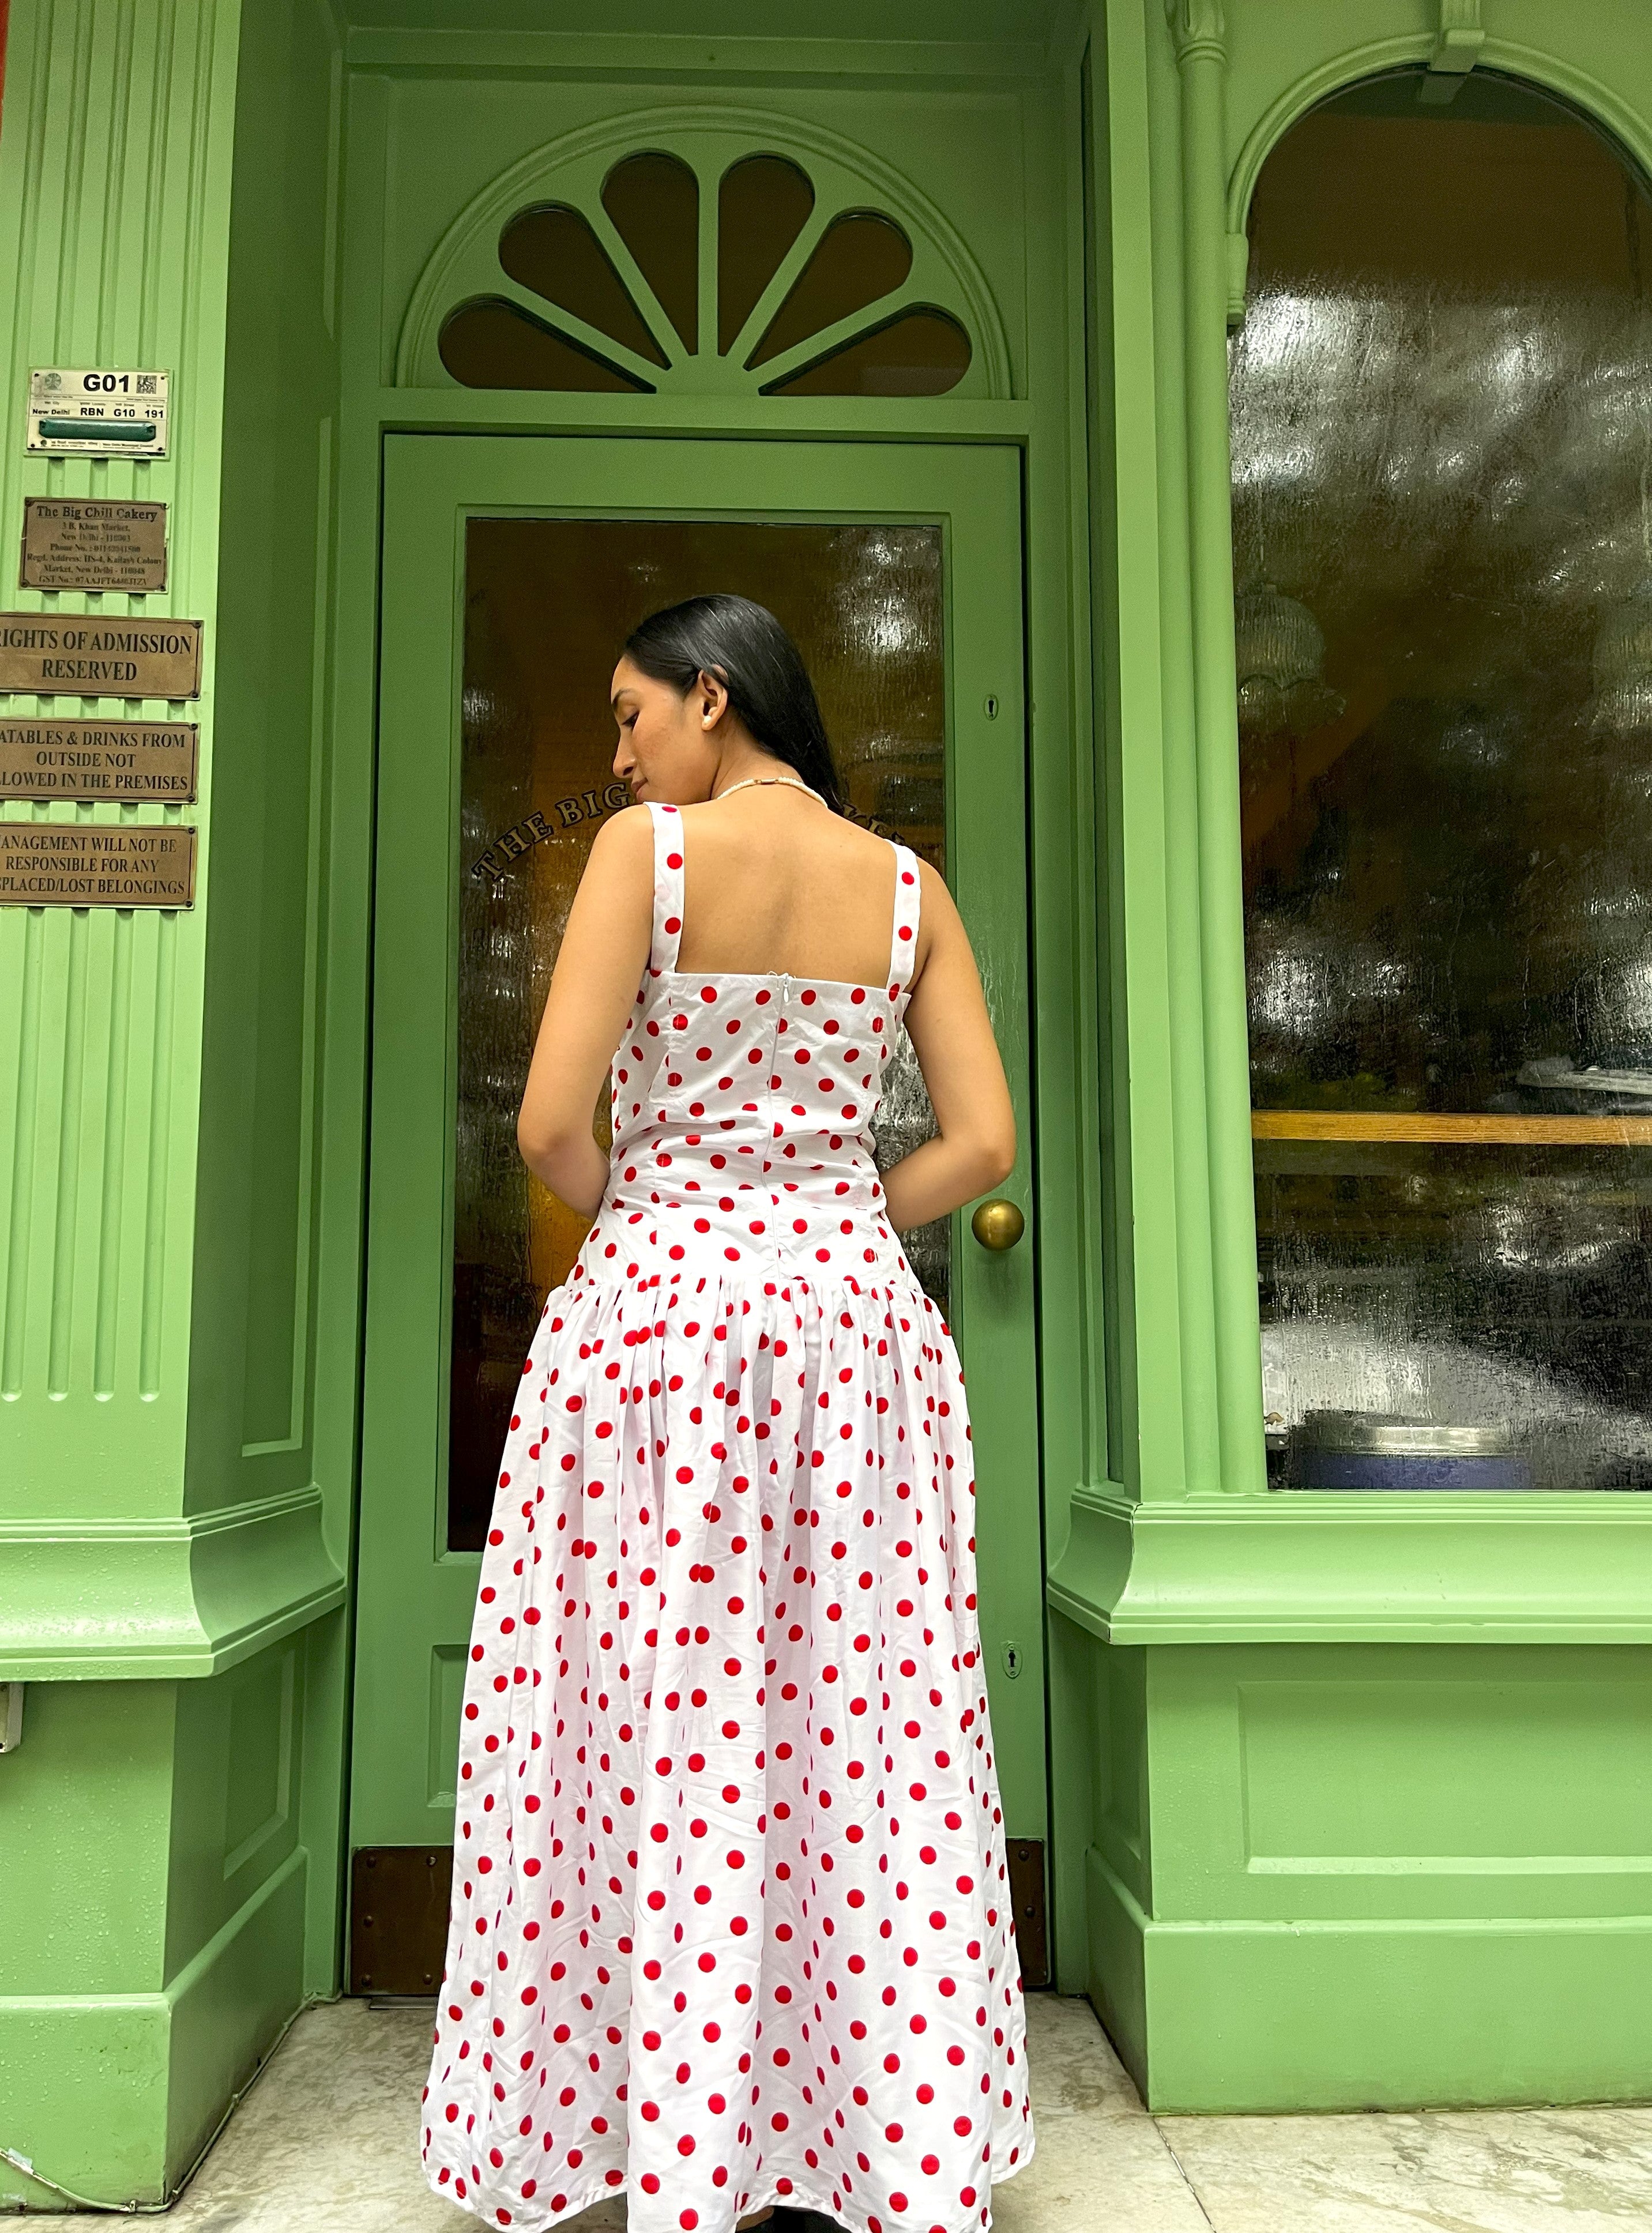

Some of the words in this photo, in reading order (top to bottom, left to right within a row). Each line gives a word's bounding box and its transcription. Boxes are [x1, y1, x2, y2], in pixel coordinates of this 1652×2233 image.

[83, 374, 129, 392] G01
[81, 408, 104, 416] RBN
[114, 409, 136, 417] G10
[145, 410, 164, 418] 191
[37, 506, 58, 517] The
[62, 506, 81, 520] Big
[85, 507, 112, 518] Chill
[116, 509, 157, 522] Cakery
[0, 629, 58, 649] IGHTS
[63, 631, 88, 650] OF
[91, 632, 193, 654] ADMISSION
[42, 659, 137, 680] RESERVED
[67, 733, 78, 745] &
[83, 732, 138, 747] DRINKS
[142, 733, 185, 748] FROM
[36, 751, 101, 767] OUTSIDE
[106, 753, 136, 767] NOT
[0, 771, 57, 786] LOWED
[61, 773, 76, 787] IN
[80, 774, 111, 788] THE
[115, 775, 187, 790] PREMISES
[471, 811, 554, 882] THE
[555, 782, 630, 828] BIG
[91, 837, 126, 852] WILL
[129, 838, 157, 852] NOT
[160, 839, 176, 853] BE
[6, 856, 97, 872] RESPONSIBLE
[101, 858, 127, 872] FOR
[131, 859, 160, 873] ANY
[98, 879, 185, 894] BELONGINGS
